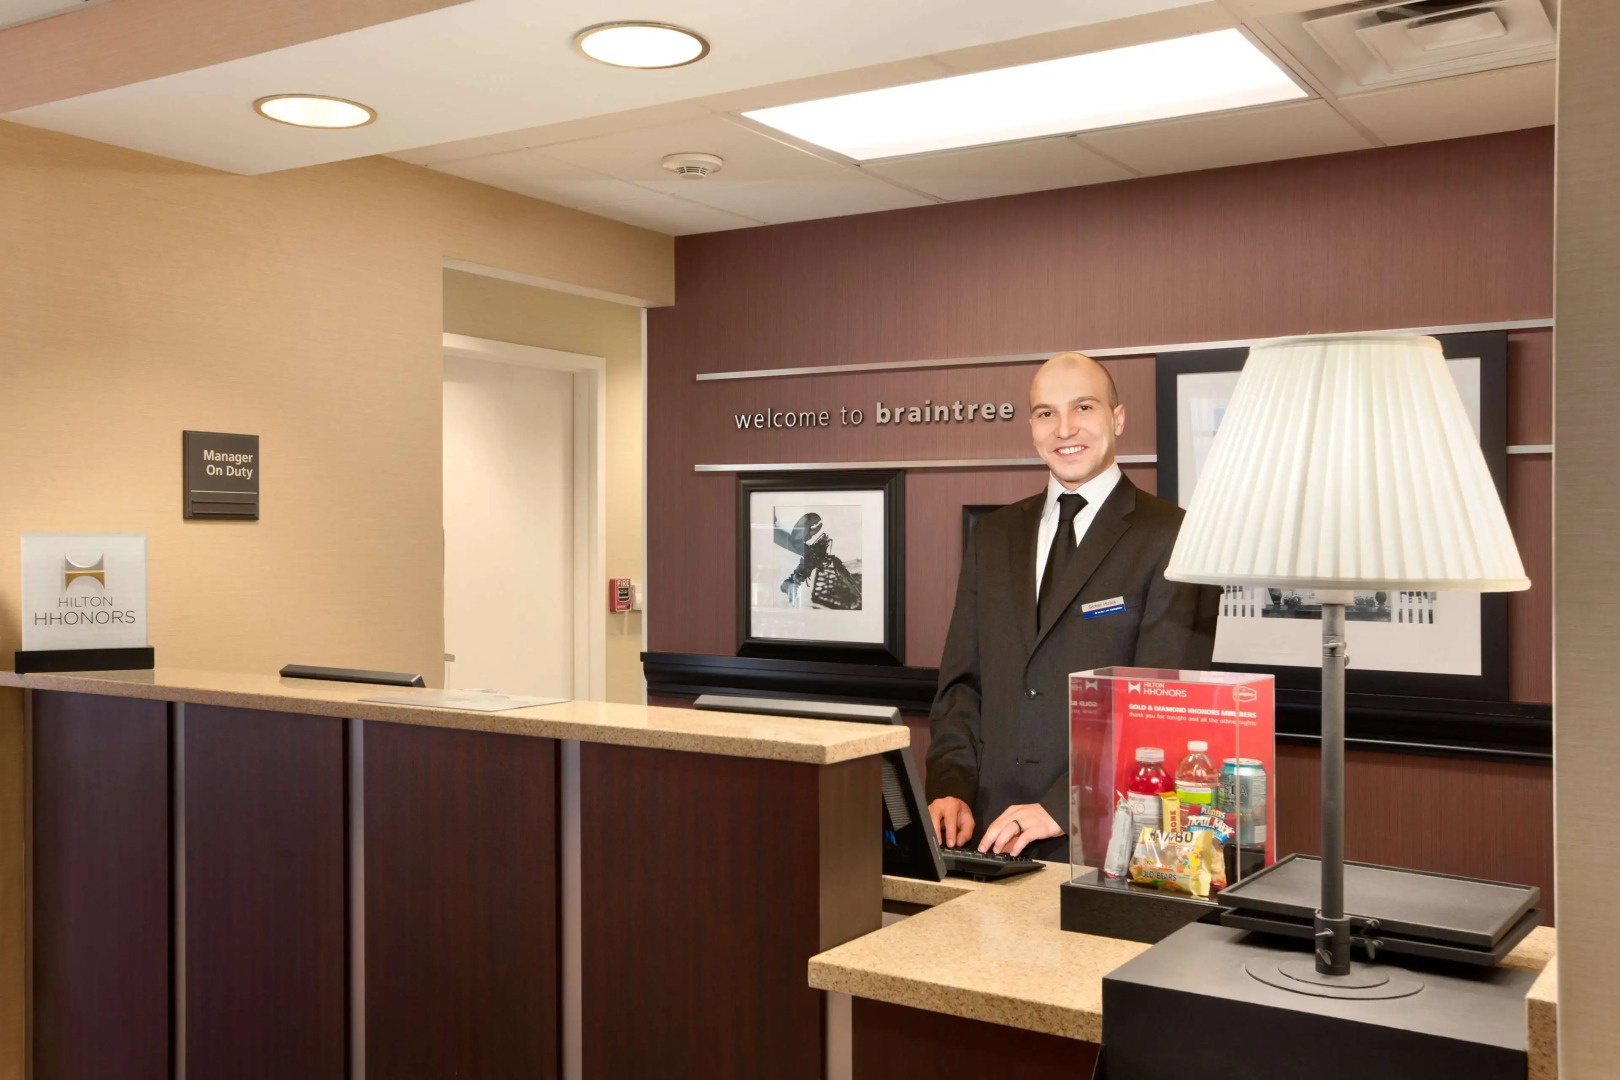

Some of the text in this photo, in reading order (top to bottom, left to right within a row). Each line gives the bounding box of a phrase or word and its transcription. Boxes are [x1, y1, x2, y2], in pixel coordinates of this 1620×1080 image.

[734, 400, 1015, 429] welcome to braintree
[203, 449, 253, 465] Manager
[206, 464, 253, 480] On Duty
[616, 579, 630, 587] FIRE
[58, 596, 113, 607] HILTON
[34, 610, 136, 625] HHONORS
[1143, 688, 1187, 697] HHONORS
[1154, 705, 1186, 713] DIAMOND
[1188, 707, 1220, 716] HHONORS
[1166, 713, 1187, 721] tonight
[1187, 815, 1235, 834] TRAIL MIX
